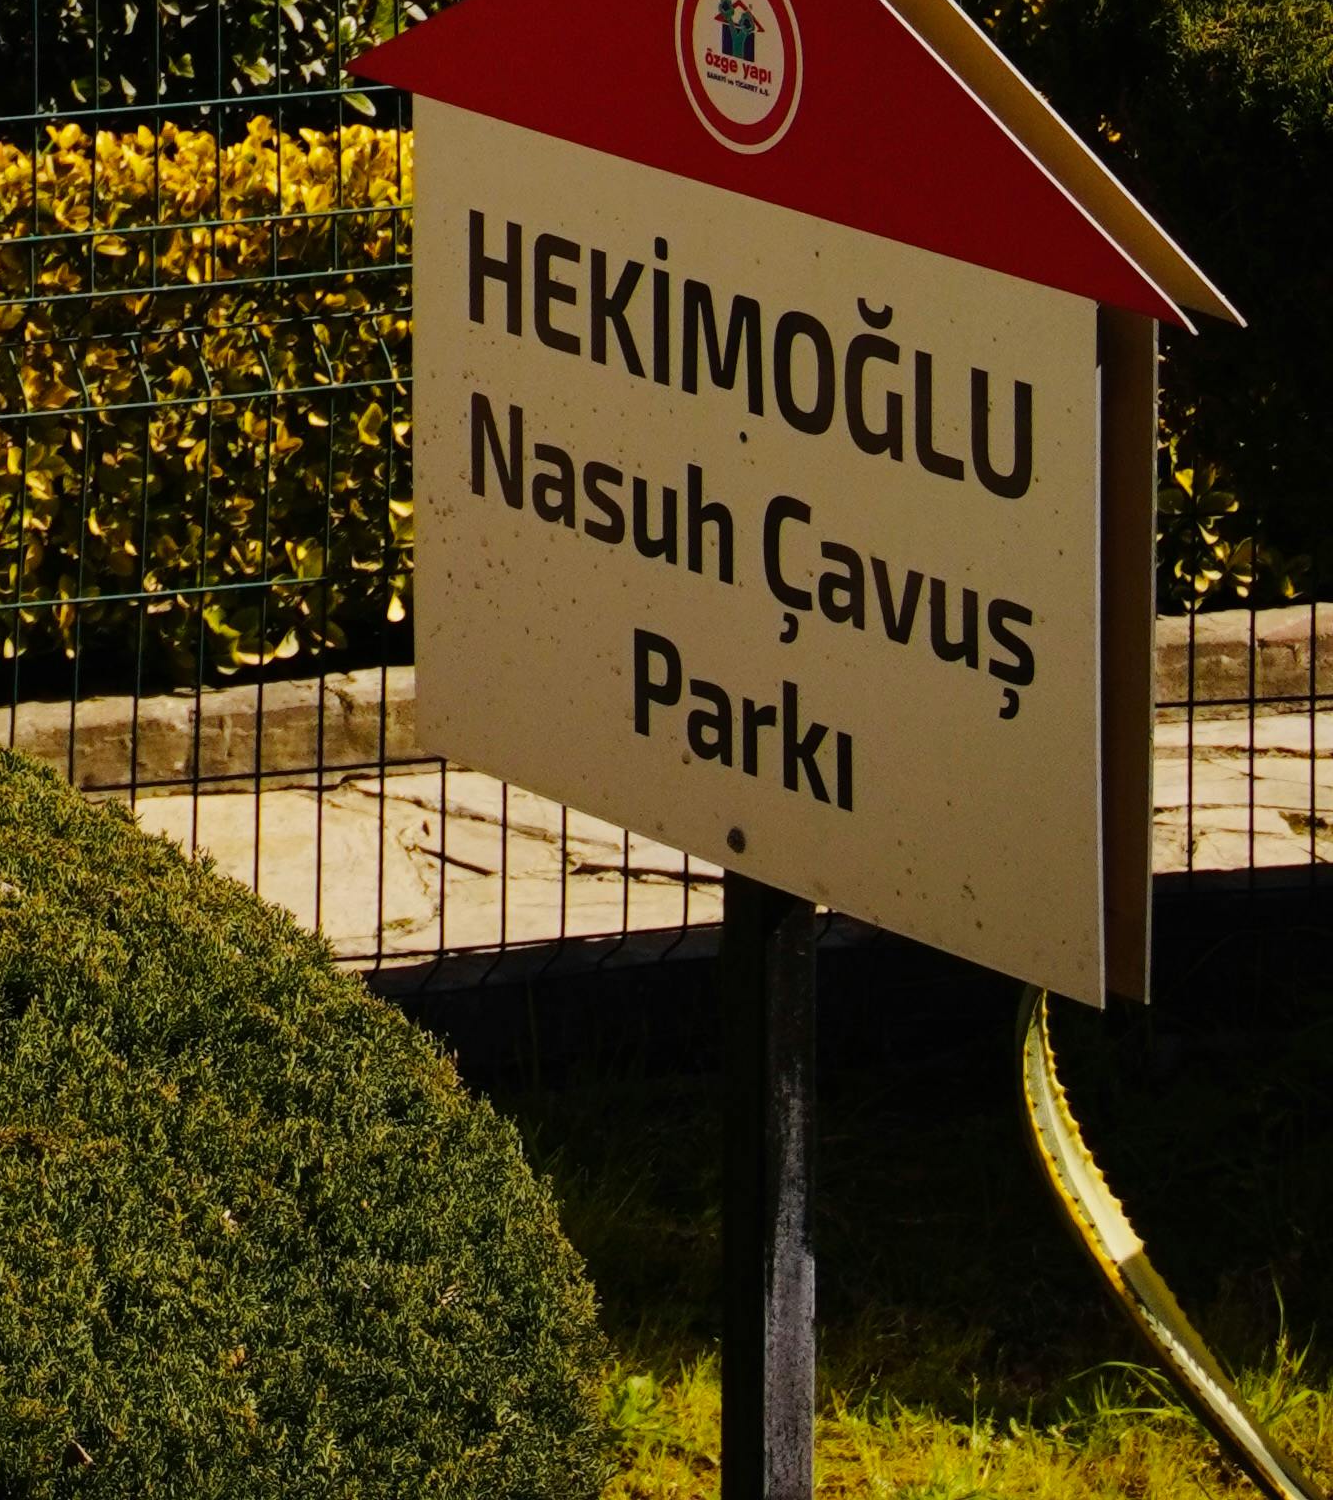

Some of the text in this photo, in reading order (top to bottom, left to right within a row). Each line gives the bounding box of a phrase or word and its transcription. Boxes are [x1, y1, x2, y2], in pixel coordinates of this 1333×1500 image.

[705, 48, 772, 85] özge yapı
[468, 208, 1035, 500] HEKİMOĞLU
[468, 391, 1036, 721] Nasuh Çavuş
[632, 627, 855, 813] Parkı
